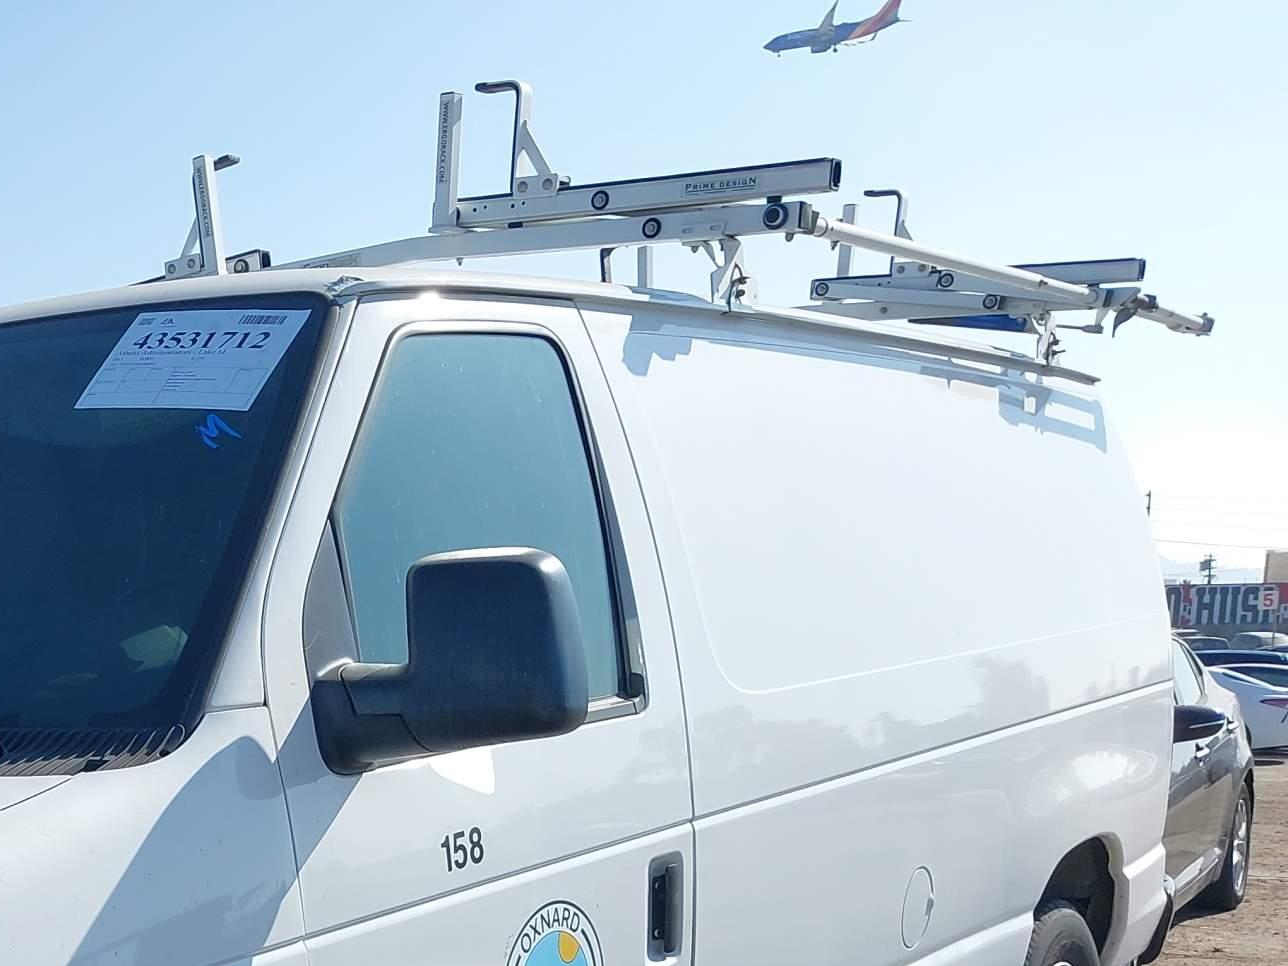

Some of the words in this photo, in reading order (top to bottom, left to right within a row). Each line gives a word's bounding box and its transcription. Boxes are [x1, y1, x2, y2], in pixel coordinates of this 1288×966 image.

[439, 102, 449, 183] WWW.ERGORACK.COM
[685, 182, 715, 191] PRIME
[719, 177, 757, 188] DESIGN
[133, 331, 271, 350] 43531712
[1263, 593, 1274, 608] 5
[441, 826, 485, 872] 158
[520, 907, 581, 954] OXNARD
